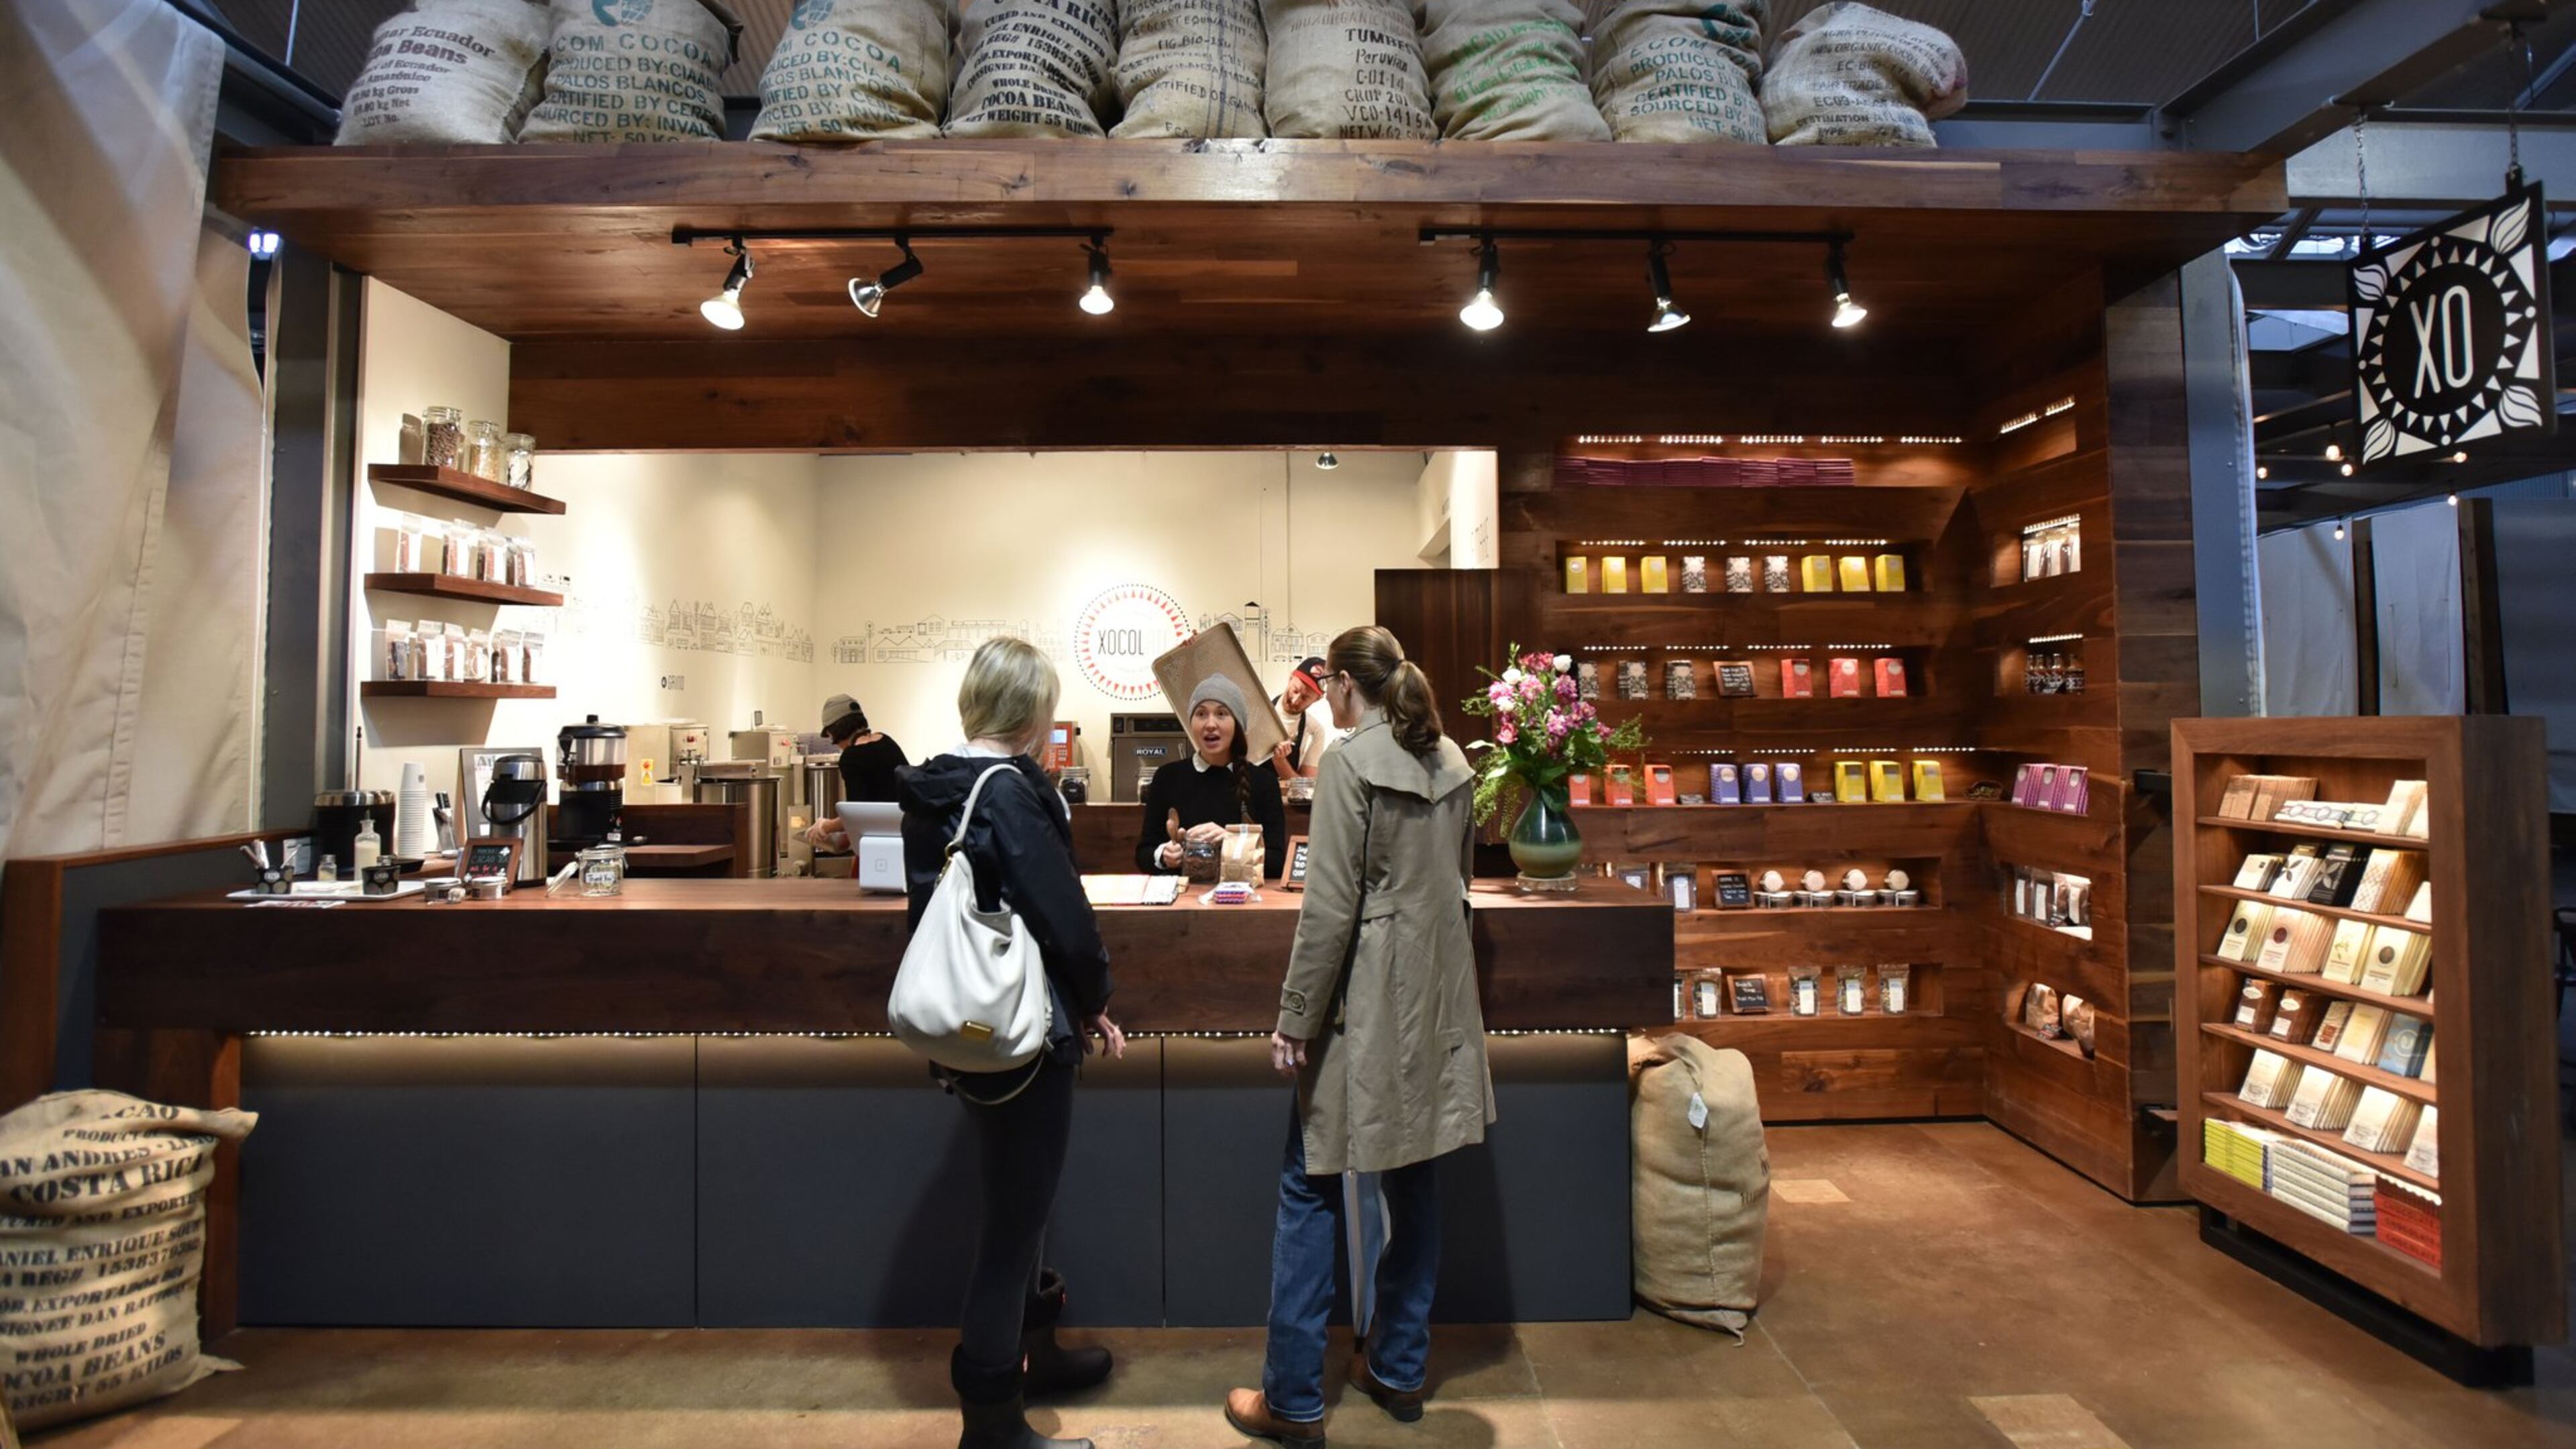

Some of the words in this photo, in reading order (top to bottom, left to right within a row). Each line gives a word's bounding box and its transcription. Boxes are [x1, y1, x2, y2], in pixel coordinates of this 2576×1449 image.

[397, 40, 469, 64] Beans
[411, 25, 496, 58] Ecuador
[619, 33, 713, 66] COCOA
[1356, 48, 1408, 72] Peruvian
[1629, 52, 1726, 75] PRODUCED
[1656, 67, 1714, 83] PALOS
[616, 76, 707, 104] BLANCOS
[981, 91, 1028, 111] COCOA
[1635, 83, 1727, 103] CERTIFIED
[634, 95, 661, 110] BY
[1630, 99, 1719, 117] SOURCED
[987, 109, 1042, 125] WEIGHT
[1044, 113, 1063, 127] 55
[2410, 284, 2474, 399] XO
[1136, 748, 1165, 756] ROYAL
[42, 1146, 151, 1172] ANDRES
[10, 1170, 131, 1204] COSTA
[140, 1152, 204, 1186] RICA
[66, 1230, 164, 1262] ENRIQUE
[79, 1305, 120, 1326] DAN
[15, 1341, 88, 1364] WHOLE
[93, 1322, 146, 1349] DRIED
[82, 1331, 166, 1377] BEANS
